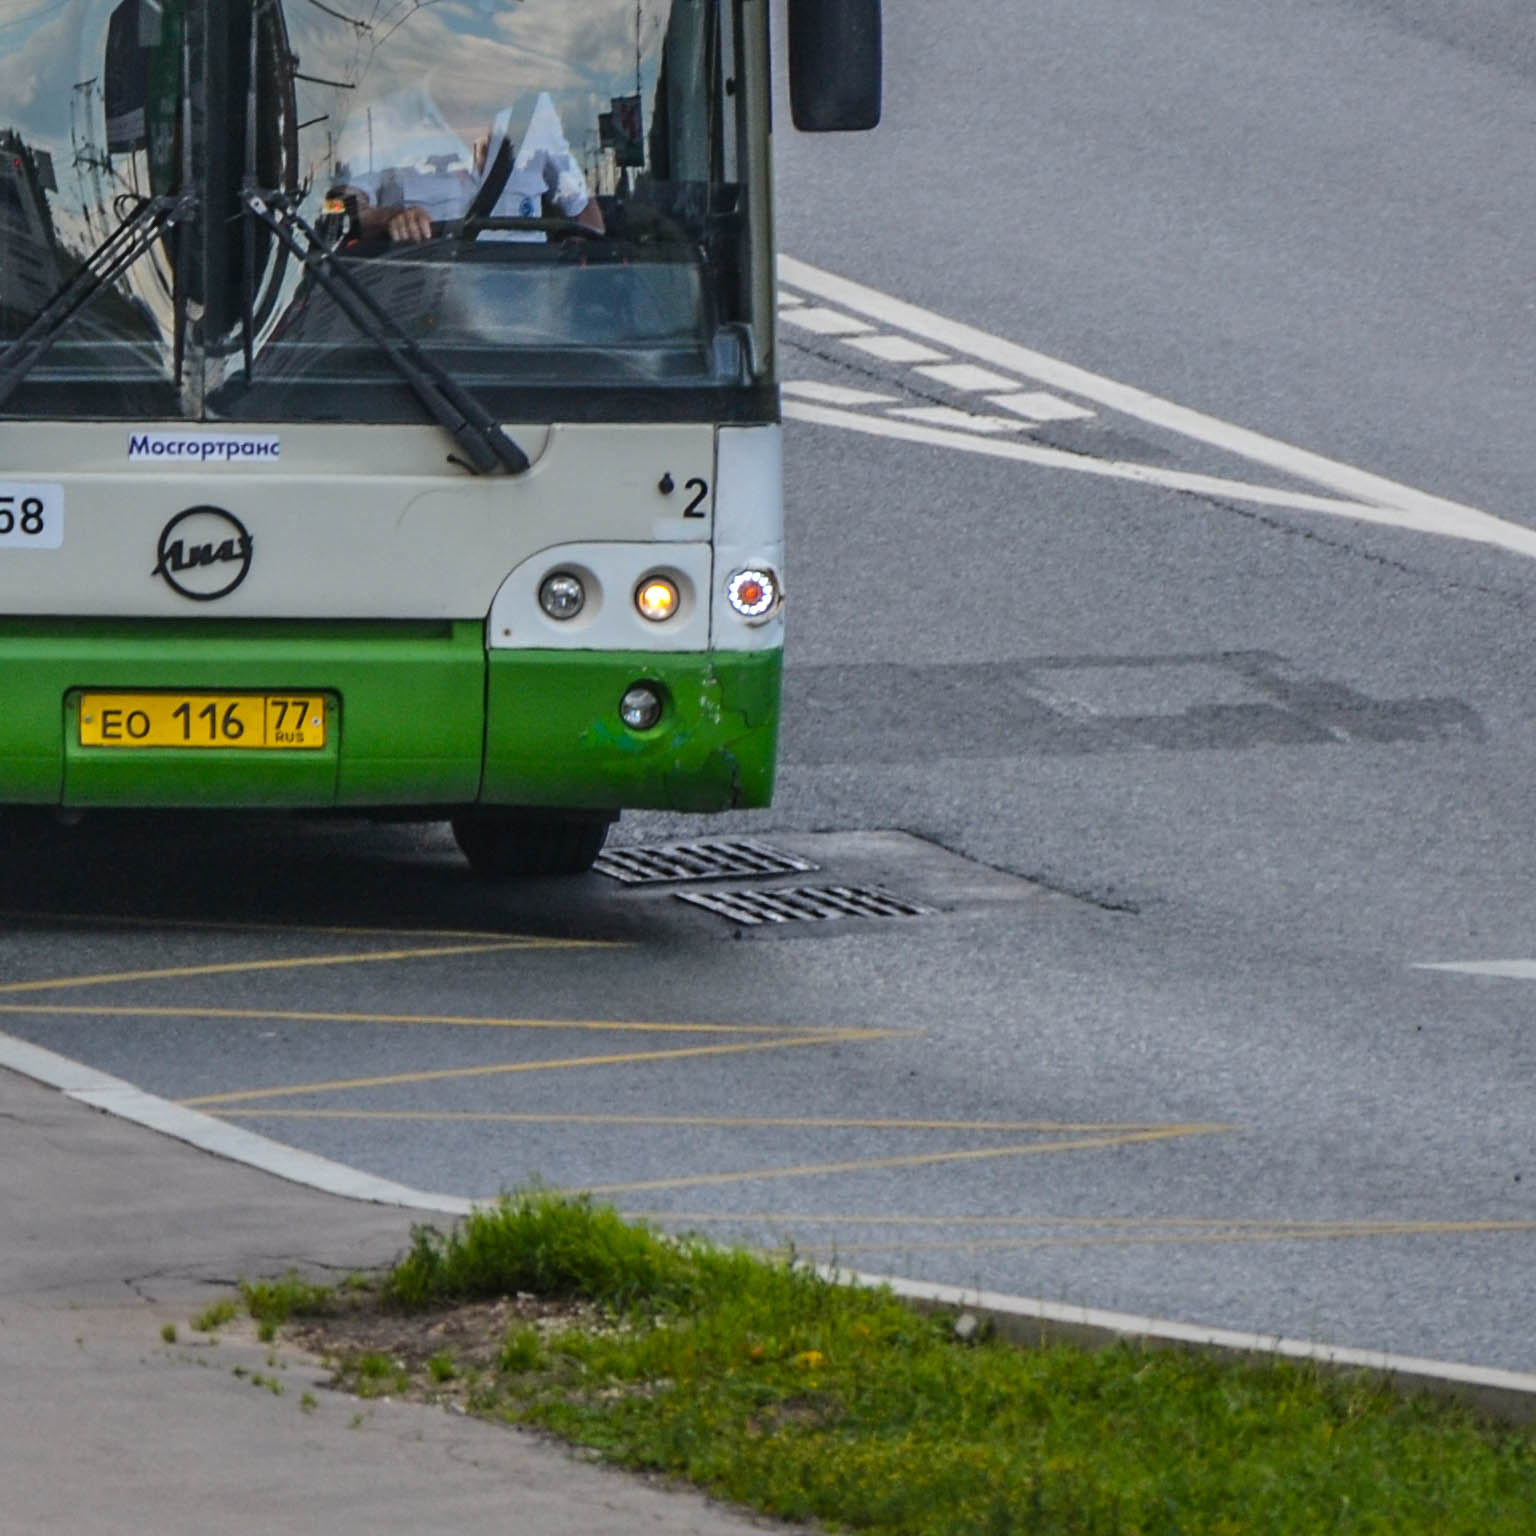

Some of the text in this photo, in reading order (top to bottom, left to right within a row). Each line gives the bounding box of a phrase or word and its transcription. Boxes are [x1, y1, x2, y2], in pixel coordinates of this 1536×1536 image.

[128, 435, 281, 461] Мосгортранс
[683, 477, 708, 518] 2
[172, 701, 245, 741] 116
[271, 700, 310, 731] 77
[275, 731, 305, 744] RUS
